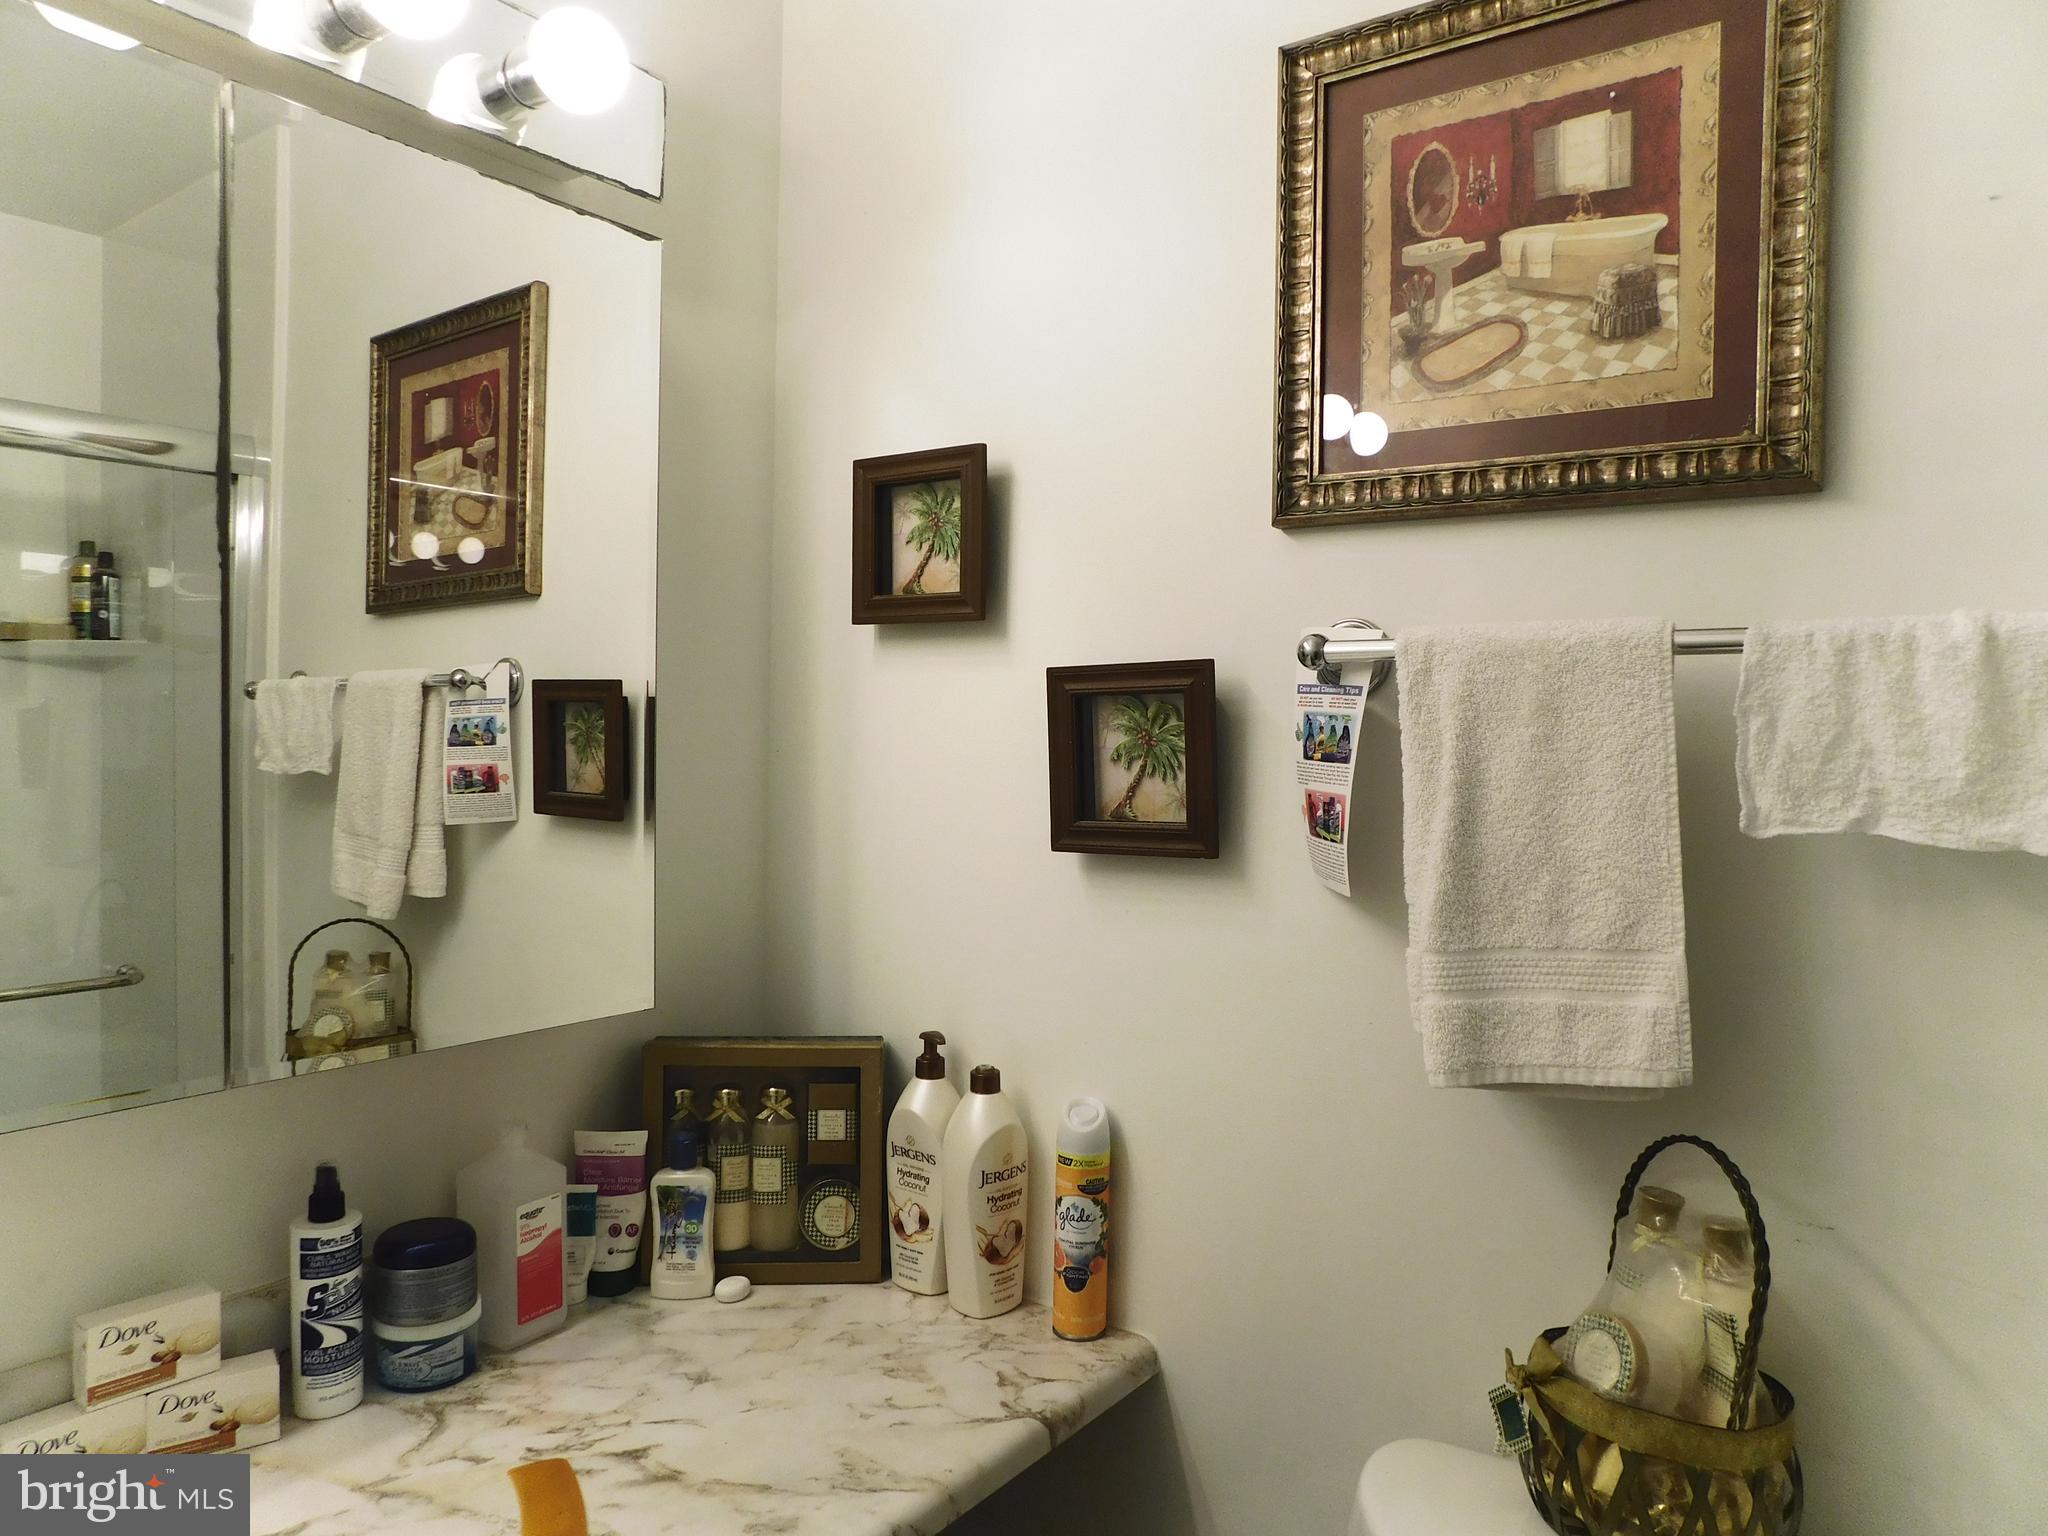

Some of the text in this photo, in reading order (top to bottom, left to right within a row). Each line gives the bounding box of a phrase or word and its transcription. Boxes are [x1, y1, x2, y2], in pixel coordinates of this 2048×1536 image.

[1321, 686, 1344, 694] Cleaning
[890, 1141, 936, 1166] JERGENS
[1058, 1156, 1071, 1166] NEW
[896, 1167, 930, 1185] Hydrating
[978, 1160, 1027, 1189] JERGENS
[898, 1178, 927, 1192] Coconut
[986, 1187, 1023, 1205] Hydrating
[990, 1198, 1020, 1213] Coconut
[1059, 1206, 1097, 1231] glade
[626, 1225, 638, 1234] AF
[685, 1224, 698, 1233] 30
[98, 1320, 158, 1349] Dove
[158, 1390, 216, 1415] Dove
[18, 1430, 79, 1454] Dove
